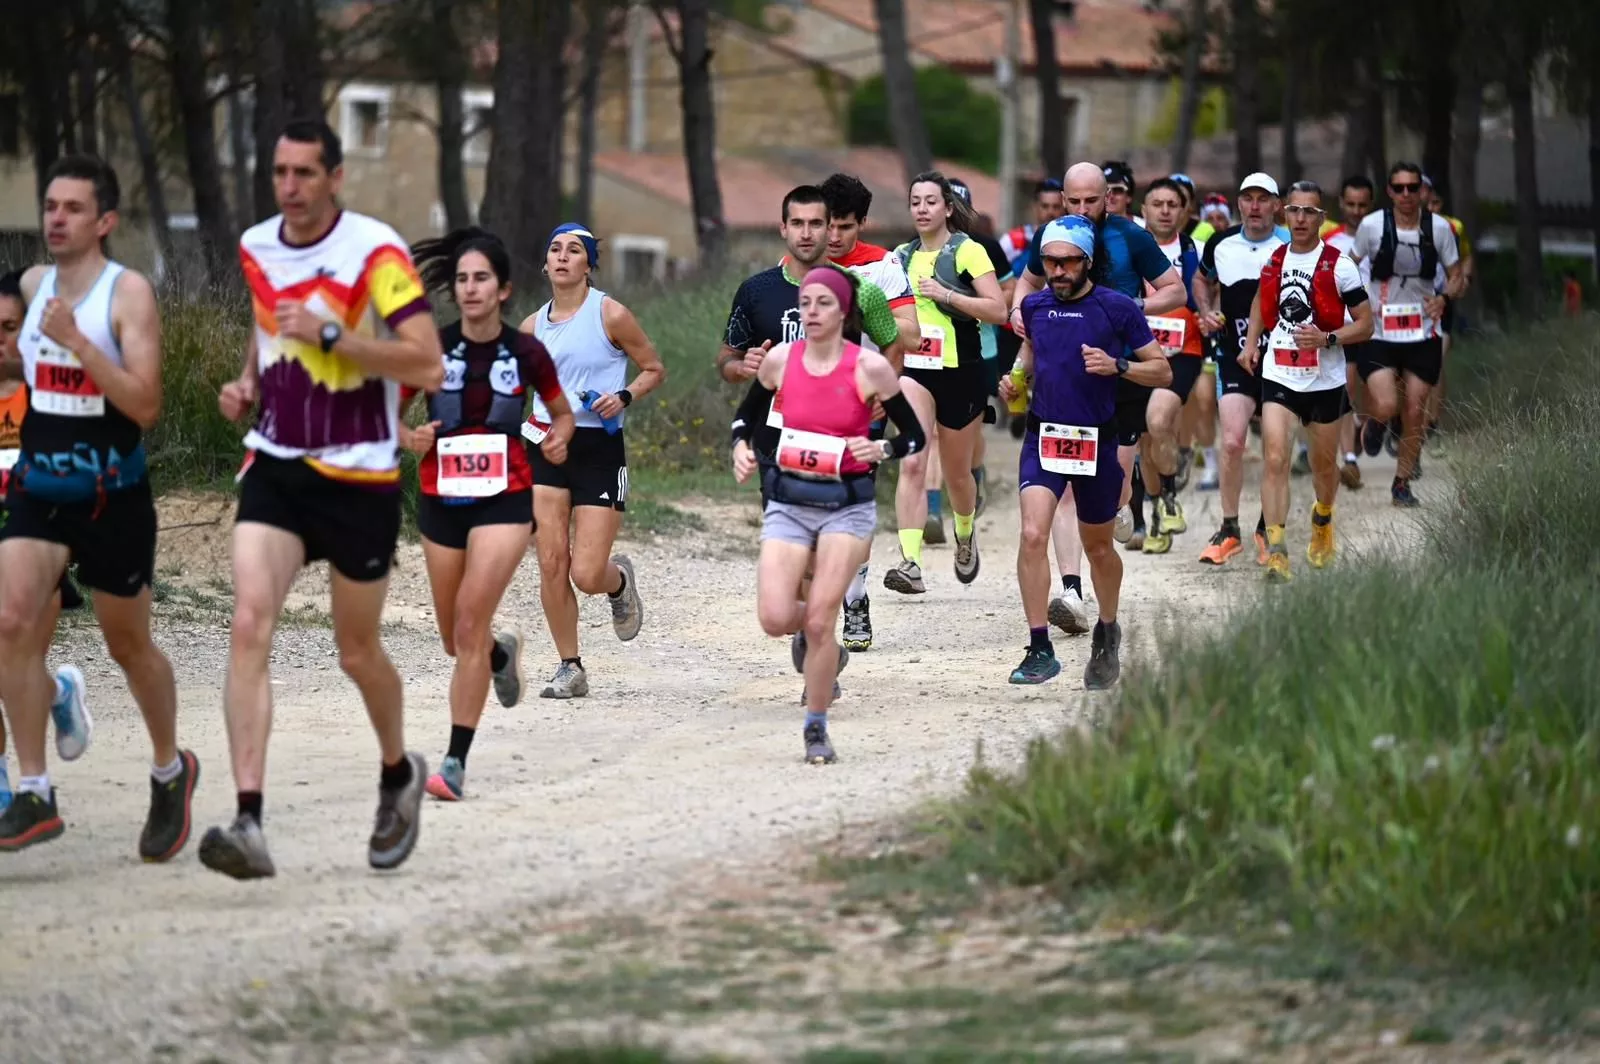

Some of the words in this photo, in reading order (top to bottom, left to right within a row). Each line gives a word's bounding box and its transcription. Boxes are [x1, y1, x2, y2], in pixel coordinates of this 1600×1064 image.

[1290, 350, 1299, 363] 9
[49, 366, 85, 388] 149
[1055, 439, 1081, 455] 121
[454, 454, 490, 472] 130
[799, 450, 819, 468] 15
